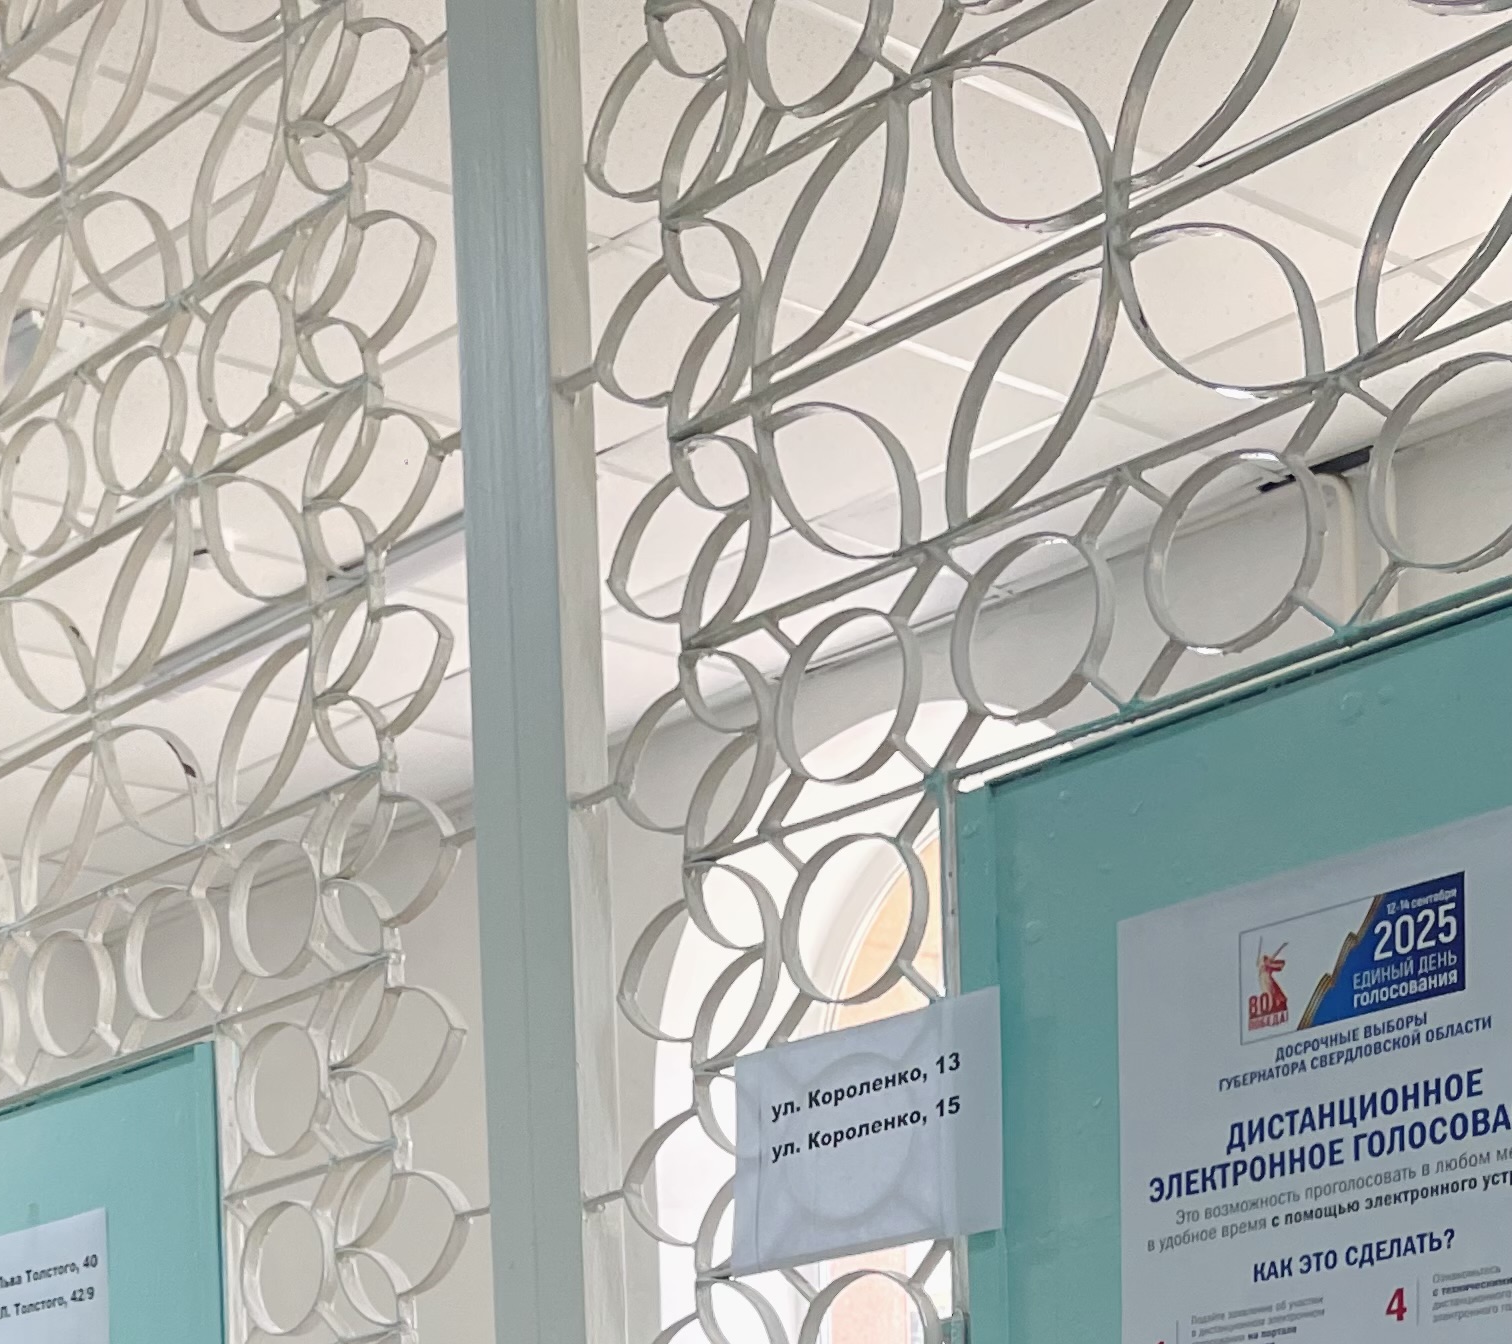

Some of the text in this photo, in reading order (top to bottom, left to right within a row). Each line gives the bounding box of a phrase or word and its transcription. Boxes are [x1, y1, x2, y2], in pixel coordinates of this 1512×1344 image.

[1373, 902, 1457, 961] 2025
[1353, 950, 1457, 990] ЕДИНЫЙ ДЕНЬ
[1353, 968, 1458, 1008] голосования
[1218, 1016, 1492, 1092] ГУБЕРНАТОРА СВЕРДЛОВСКОЙ ОБЛАСТИ
[1275, 1012, 1427, 1062] ДОСРОЧНЫЕ ВЫБОРЫ
[771, 1052, 961, 1122] ул. Короленко, 13
[1226, 1067, 1484, 1155] ДИСТАНЦИОННОЕ
[772, 1095, 961, 1163] ул. Короленко, 15
[1149, 1104, 1512, 1202] ЭЛЕКТРОННОЕ ГОЛОСОВА
[1147, 1239, 1155, 1252] в
[1159, 1227, 1217, 1253] удобное
[1221, 1218, 1267, 1239] время
[1271, 1215, 1280, 1228] с
[1284, 1200, 1359, 1225] помощью
[1364, 1177, 1477, 1210] электронного
[1175, 1209, 1200, 1225] Это
[1204, 1190, 1300, 1219] возможность
[1305, 1167, 1416, 1201] проголосовать
[1421, 1163, 1430, 1176] в
[1435, 1151, 1491, 1174] любом
[82, 1254, 99, 1268] 40
[1254, 1228, 1455, 1283] КАК ЭТО СДЕЛАТЬ?
[1386, 1287, 1407, 1321] 4
